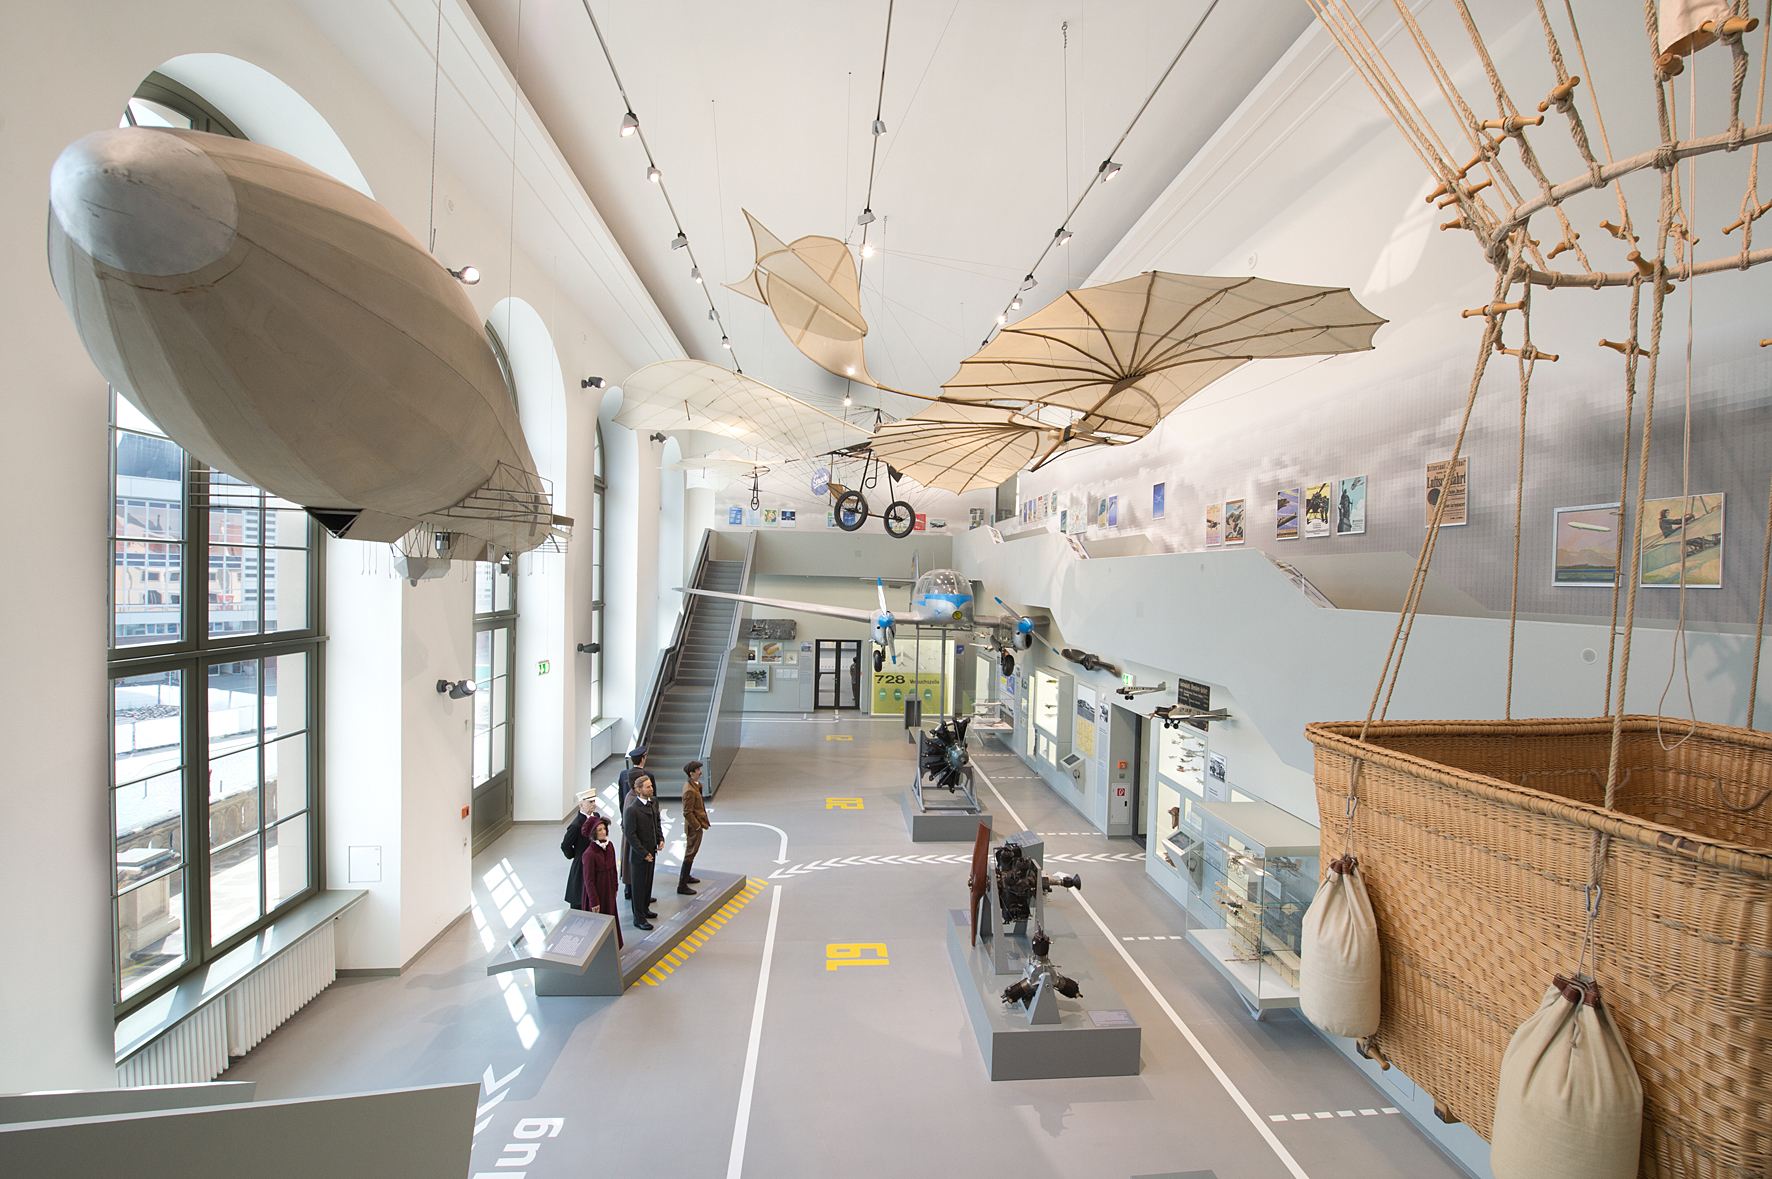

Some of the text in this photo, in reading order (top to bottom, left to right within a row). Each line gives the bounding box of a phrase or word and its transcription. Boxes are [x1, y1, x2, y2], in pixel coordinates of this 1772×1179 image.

[875, 675, 905, 684] 728
[826, 798, 864, 810] 20
[826, 943, 889, 971] 19
